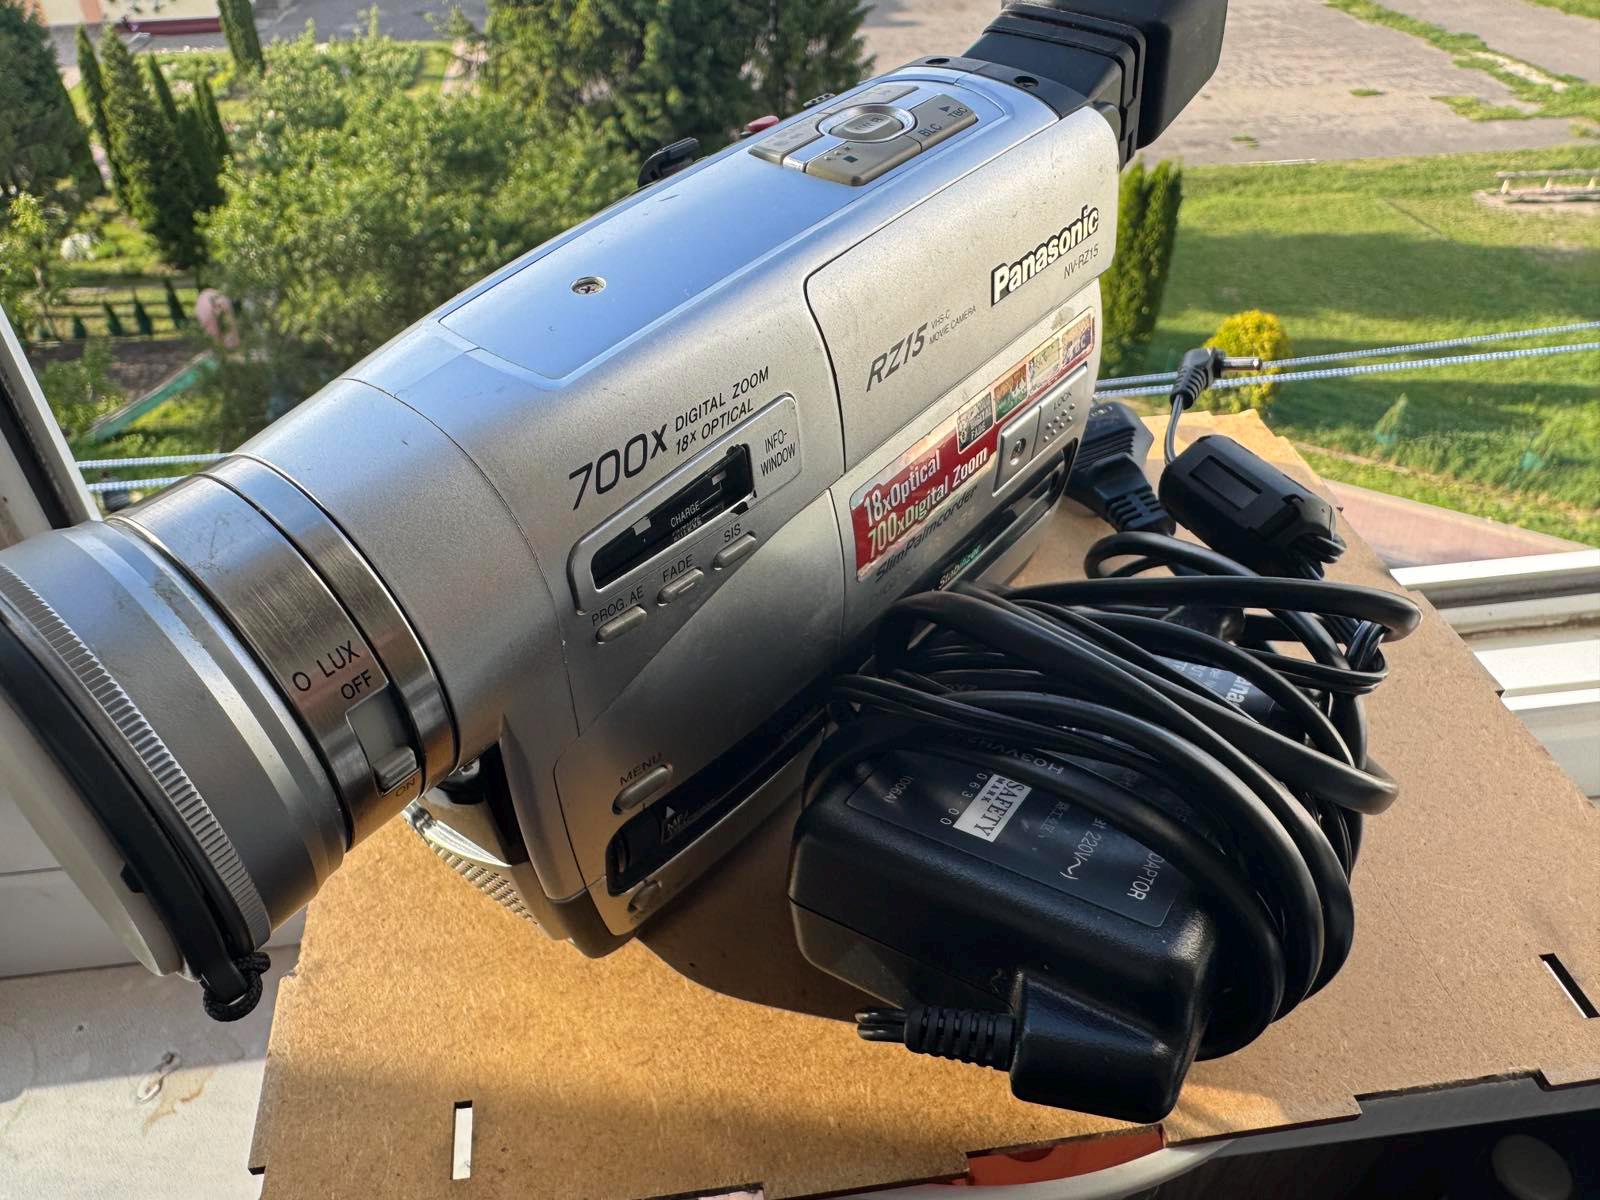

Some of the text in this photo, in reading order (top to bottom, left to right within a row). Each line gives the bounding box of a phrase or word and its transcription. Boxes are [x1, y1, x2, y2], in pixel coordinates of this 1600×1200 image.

[917, 122, 943, 138] BLC
[991, 204, 1100, 307] Panasonic
[1063, 243, 1099, 280] NV-RZ15
[929, 304, 976, 344] MOVIE CAMERA
[866, 322, 929, 392] RZ15
[675, 366, 769, 433] DIGITAL ZOOM
[701, 398, 754, 440] OPTICAL
[764, 429, 788, 453] INFO-
[760, 442, 796, 477] WINDOW
[952, 448, 988, 488] Zoom
[670, 500, 700, 528] CHARGE
[724, 522, 741, 543] SIS
[662, 554, 693, 582] FADE
[316, 640, 361, 678] LUX
[340, 669, 372, 700] OFF
[395, 777, 416, 797] ON
[619, 752, 663, 787] MENU
[981, 777, 1004, 803] MARK
[973, 780, 1025, 837] SAFETY
[1127, 852, 1166, 900] DAPTOR
